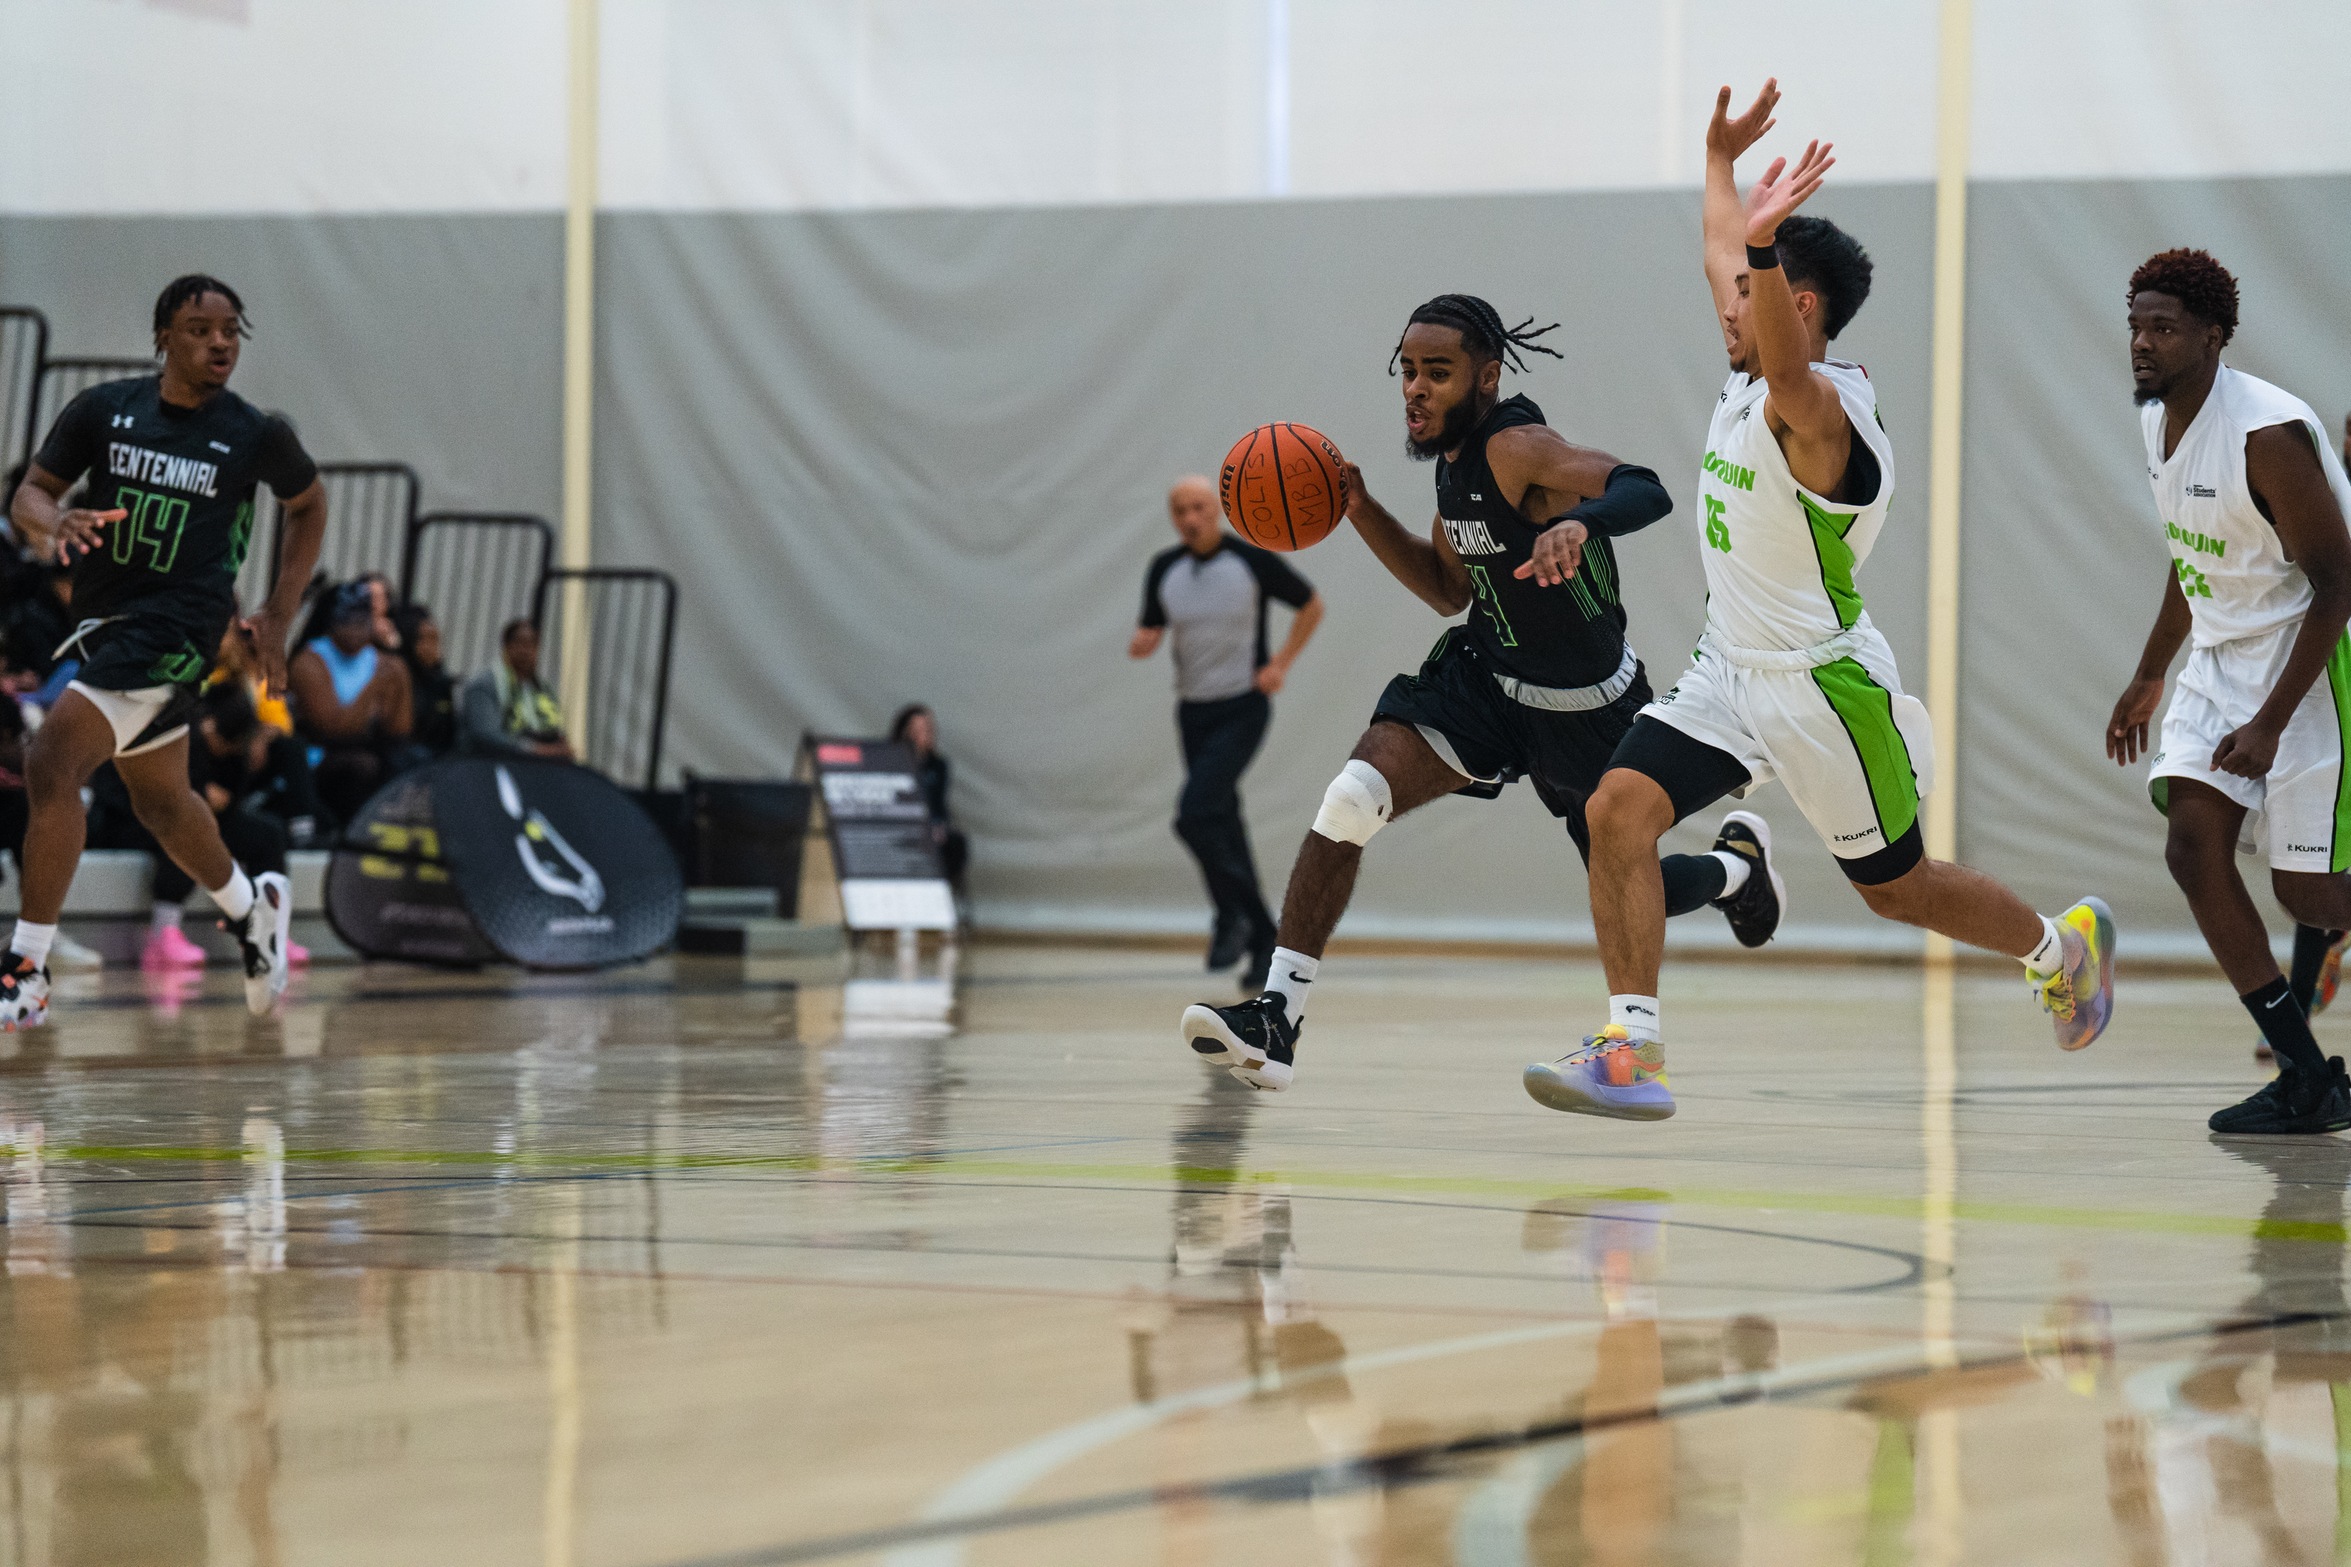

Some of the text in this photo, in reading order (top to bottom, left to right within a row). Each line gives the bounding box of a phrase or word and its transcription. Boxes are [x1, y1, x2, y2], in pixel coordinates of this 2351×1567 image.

[109, 441, 219, 499] CENTENNIAL
[1244, 453, 1281, 540] COLTS
[1283, 457, 1325, 527] MBB
[112, 485, 191, 574] 14
[1441, 516, 1508, 556] TENNIAL
[1842, 826, 1878, 841] KUKRI
[2294, 844, 2328, 853] KUKRI
